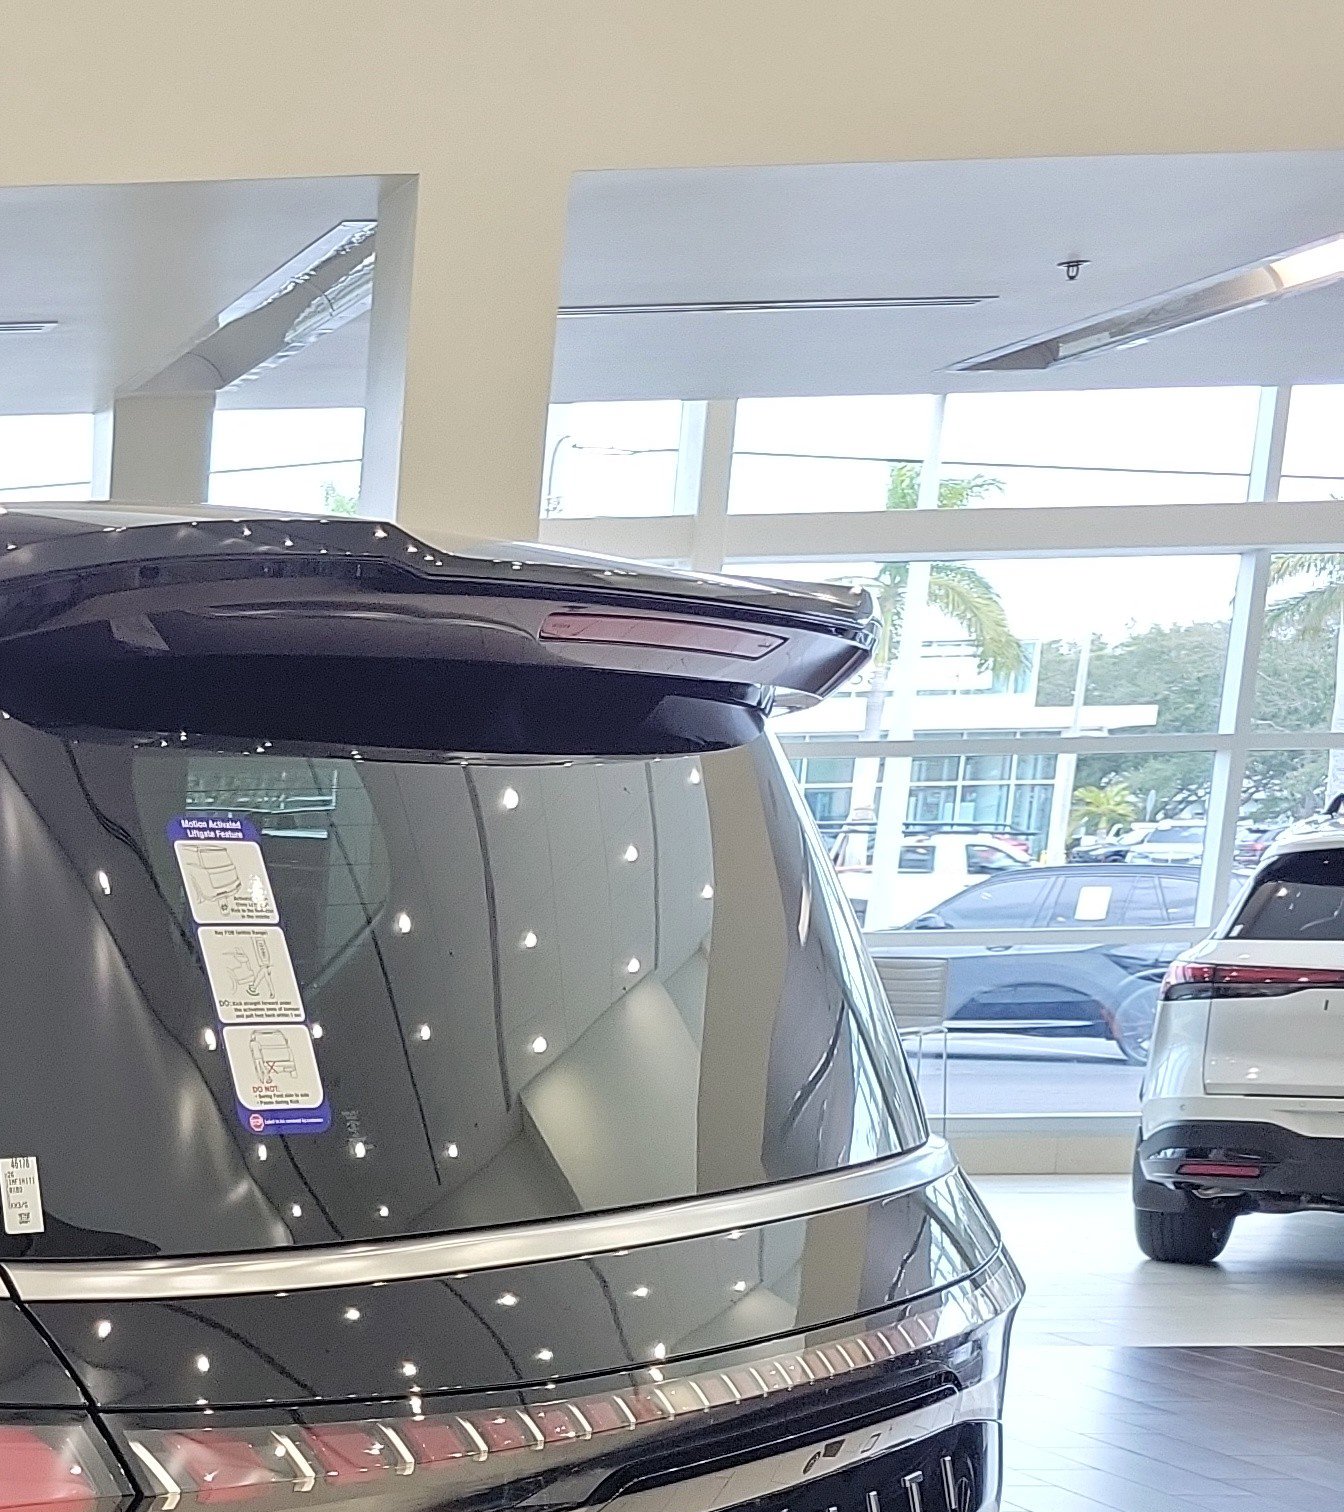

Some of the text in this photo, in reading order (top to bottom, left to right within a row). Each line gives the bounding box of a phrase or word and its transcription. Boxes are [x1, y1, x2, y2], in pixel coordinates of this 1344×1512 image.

[181, 819, 241, 829] Motion Activated
[186, 829, 243, 839] Liftgate Feature
